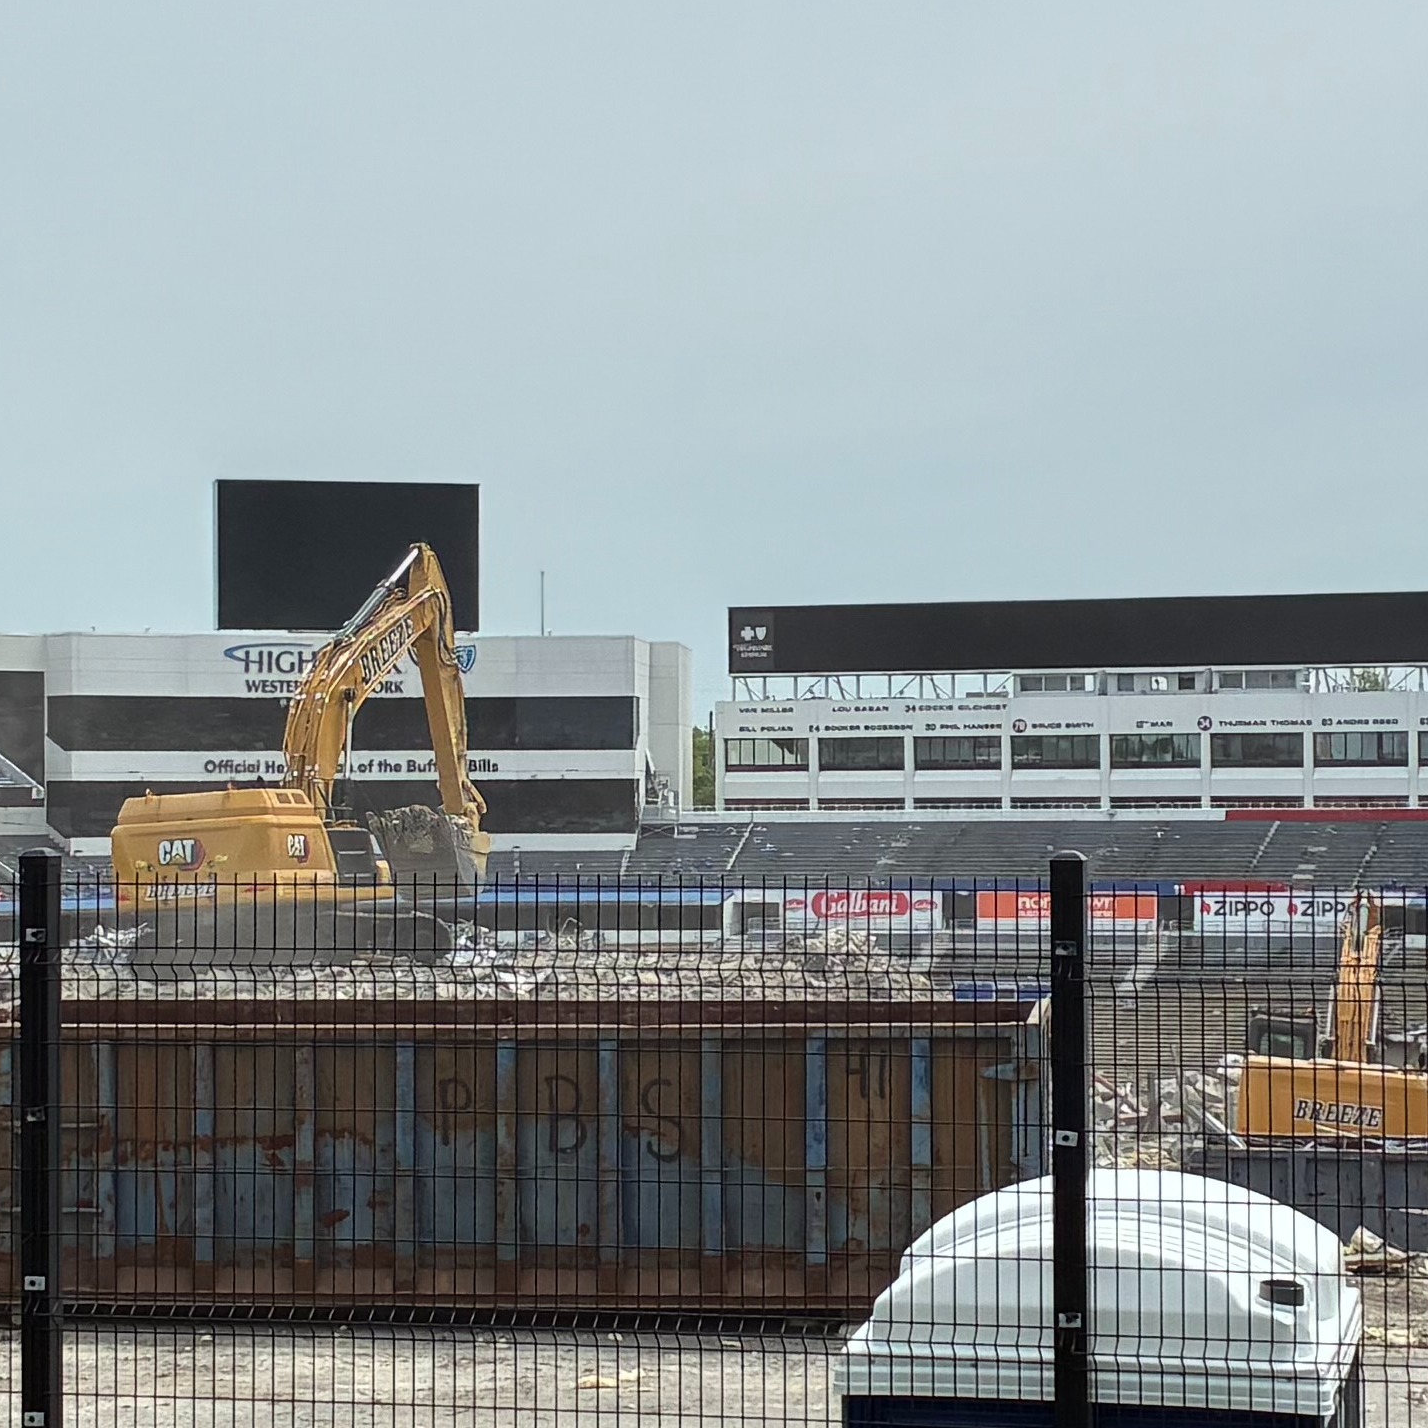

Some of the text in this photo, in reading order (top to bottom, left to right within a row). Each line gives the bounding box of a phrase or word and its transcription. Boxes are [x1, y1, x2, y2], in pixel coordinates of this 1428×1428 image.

[370, 680, 404, 693] ORK
[204, 760, 261, 773] Official
[377, 759, 402, 773] the
[468, 759, 498, 773] Bills
[158, 839, 197, 866] CAT
[287, 834, 306, 857] CAT
[820, 892, 898, 915] Galbani
[1213, 900, 1274, 916] ZIPPO
[1294, 1099, 1382, 1127] BREEZE
